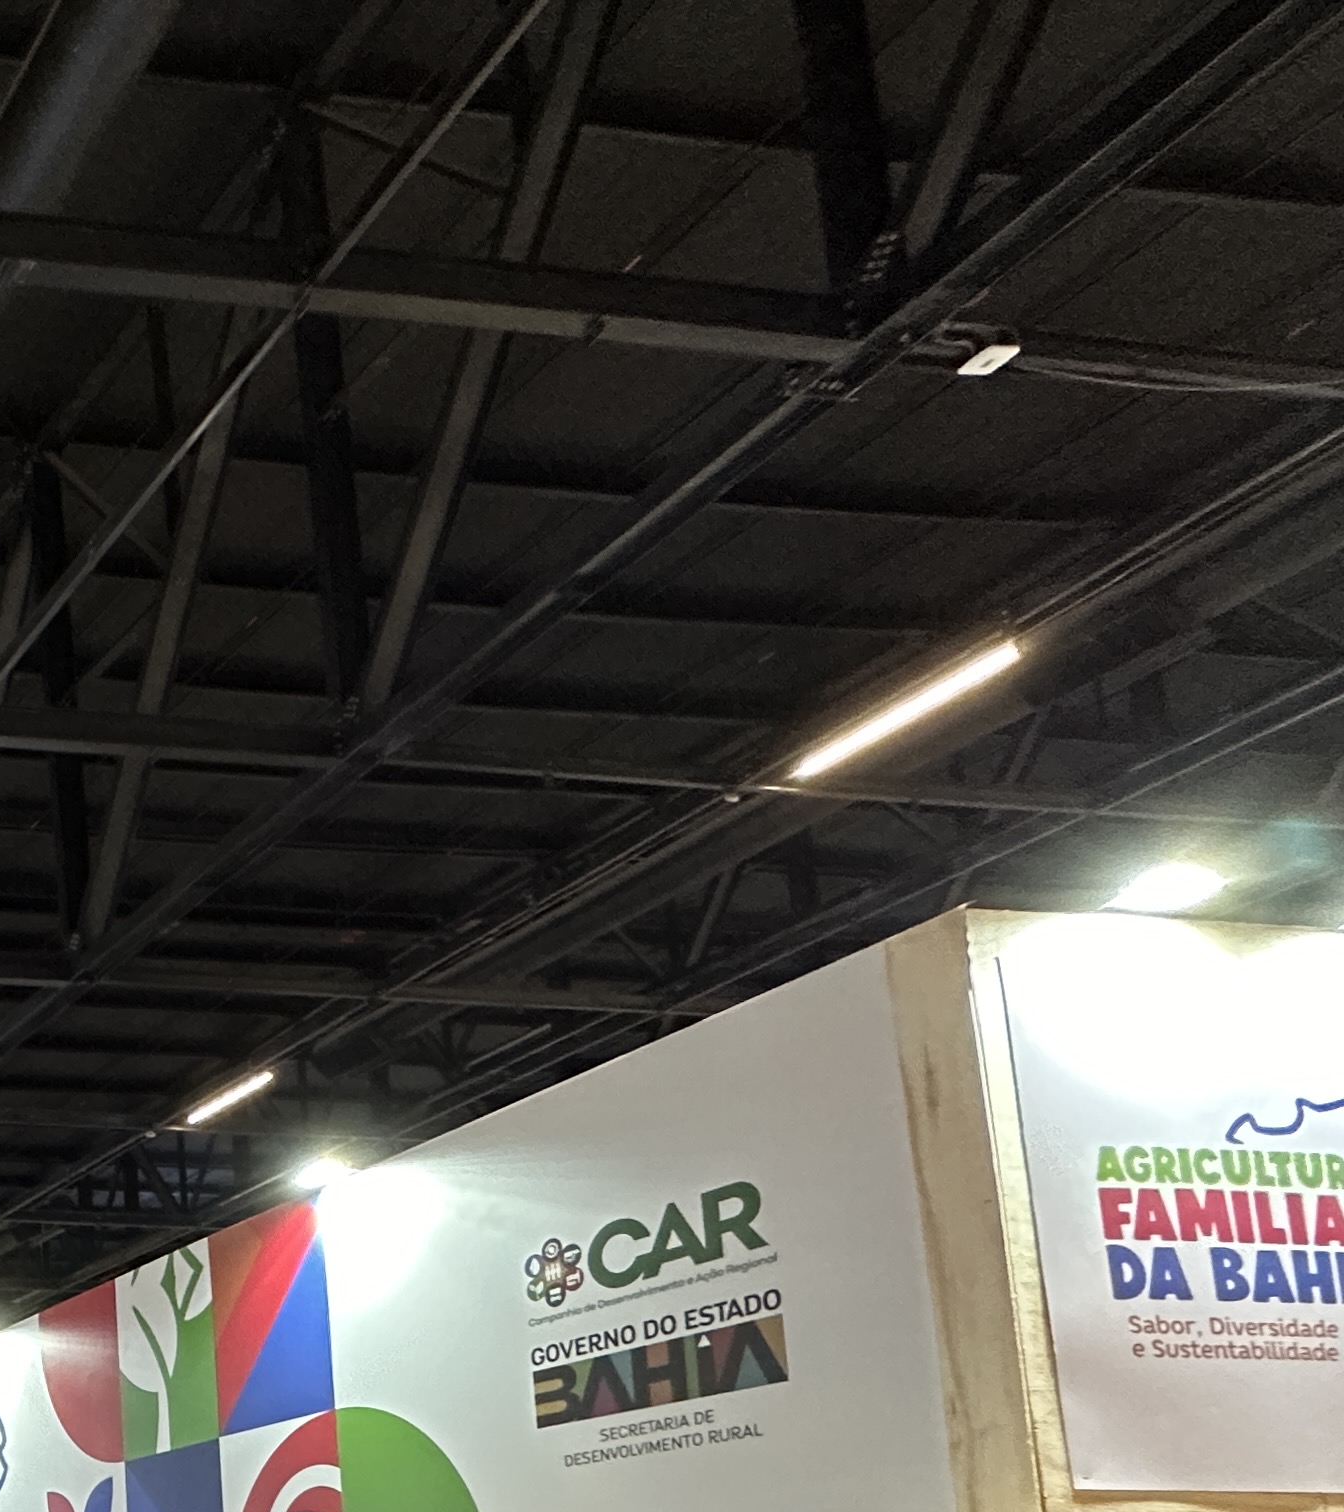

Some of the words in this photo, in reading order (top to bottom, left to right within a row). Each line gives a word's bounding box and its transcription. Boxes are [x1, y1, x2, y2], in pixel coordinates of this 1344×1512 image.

[587, 1180, 770, 1289] CAR
[584, 1301, 597, 1312] de
[598, 1278, 686, 1310] Desenvolvimento
[726, 1253, 778, 1274] Regional
[1106, 1244, 1193, 1301] DA
[531, 1325, 636, 1366] GOVERNO
[643, 1315, 677, 1340] DO
[684, 1288, 782, 1331] ESTADO
[1128, 1315, 1202, 1339] Sabor,
[1211, 1316, 1339, 1339] Diversidade
[1133, 1342, 1146, 1358] e
[1153, 1339, 1339, 1362] Sustentabilidade
[533, 1313, 789, 1429] BAHIA
[564, 1433, 704, 1468] DESENVOLVIMENTO
[709, 1423, 764, 1445] RURAL
[599, 1415, 690, 1442] SECRETARIA
[694, 1409, 715, 1425] DE
